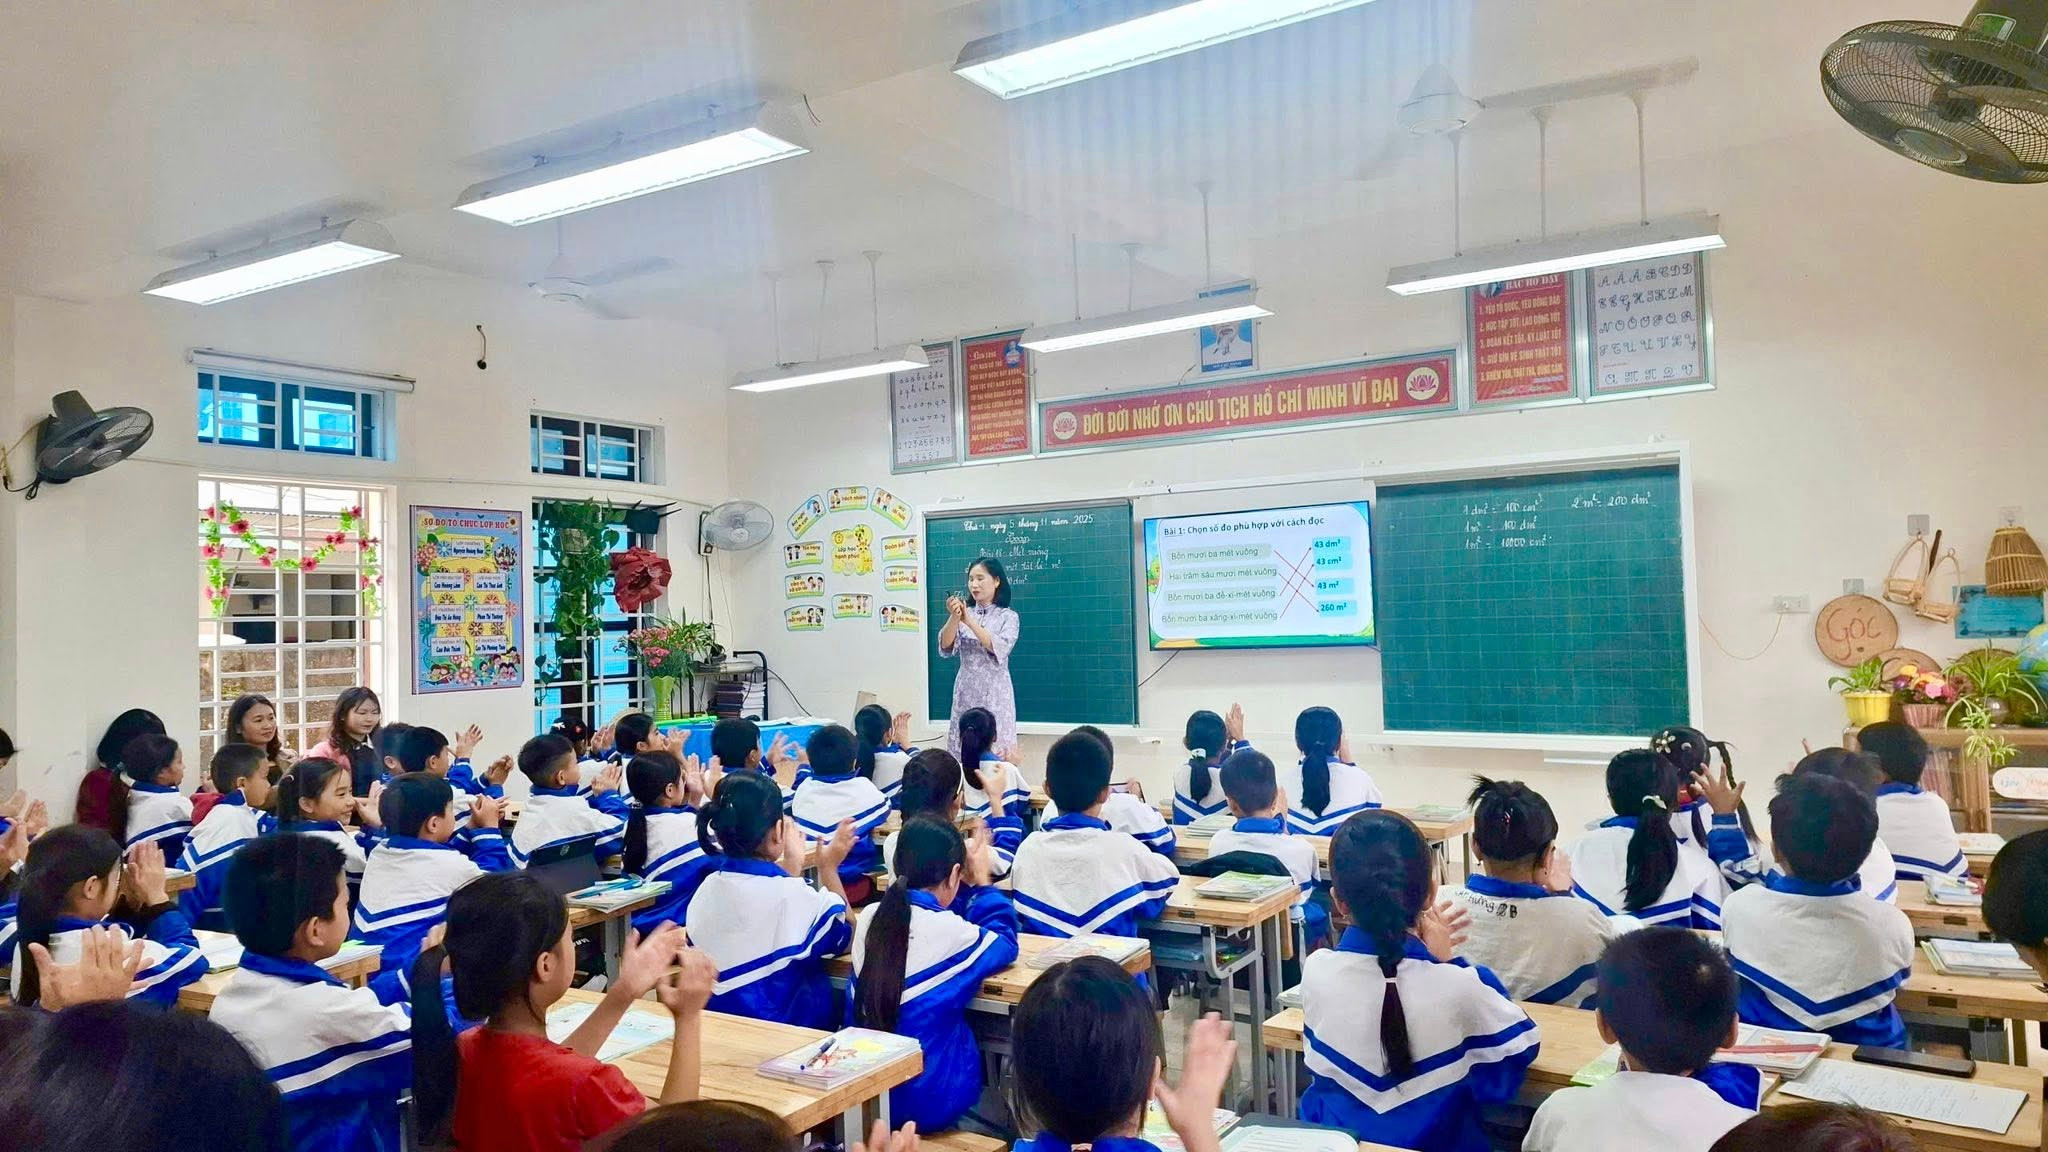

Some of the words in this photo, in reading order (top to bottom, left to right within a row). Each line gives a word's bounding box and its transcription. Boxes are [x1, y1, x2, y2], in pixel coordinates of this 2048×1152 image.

[1083, 408, 1103, 435] ĐỜI
[1108, 405, 1129, 432] ĐỜI
[1133, 400, 1160, 430] NHỚ
[1164, 402, 1182, 426] ƠN
[1187, 390, 1213, 424] CHỦ
[1218, 396, 1249, 424] TỊCH
[1254, 386, 1272, 416] HỒ
[1278, 384, 1301, 414] CHÍ
[1307, 383, 1347, 411] MINH
[1352, 376, 1367, 405] VĨ
[1372, 377, 1398, 407] ĐẠI
[1607, 496, 1627, 506] 200
[1505, 503, 1519, 512] 100
[1010, 520, 1014, 528] 5
[1073, 514, 1094, 524] 2025
[1504, 520, 1516, 530] 100
[1164, 528, 1177, 536] Bài
[1188, 526, 1207, 535] Chọn
[1210, 523, 1219, 532] số
[1234, 522, 1250, 531] phù
[1252, 521, 1268, 530] hợp
[1271, 520, 1285, 528] với
[1287, 518, 1305, 526] cách
[1306, 517, 1324, 526] đọc
[1236, 548, 1258, 556] vuông
[1253, 568, 1277, 576] vuông
[1253, 590, 1275, 598] vuông
